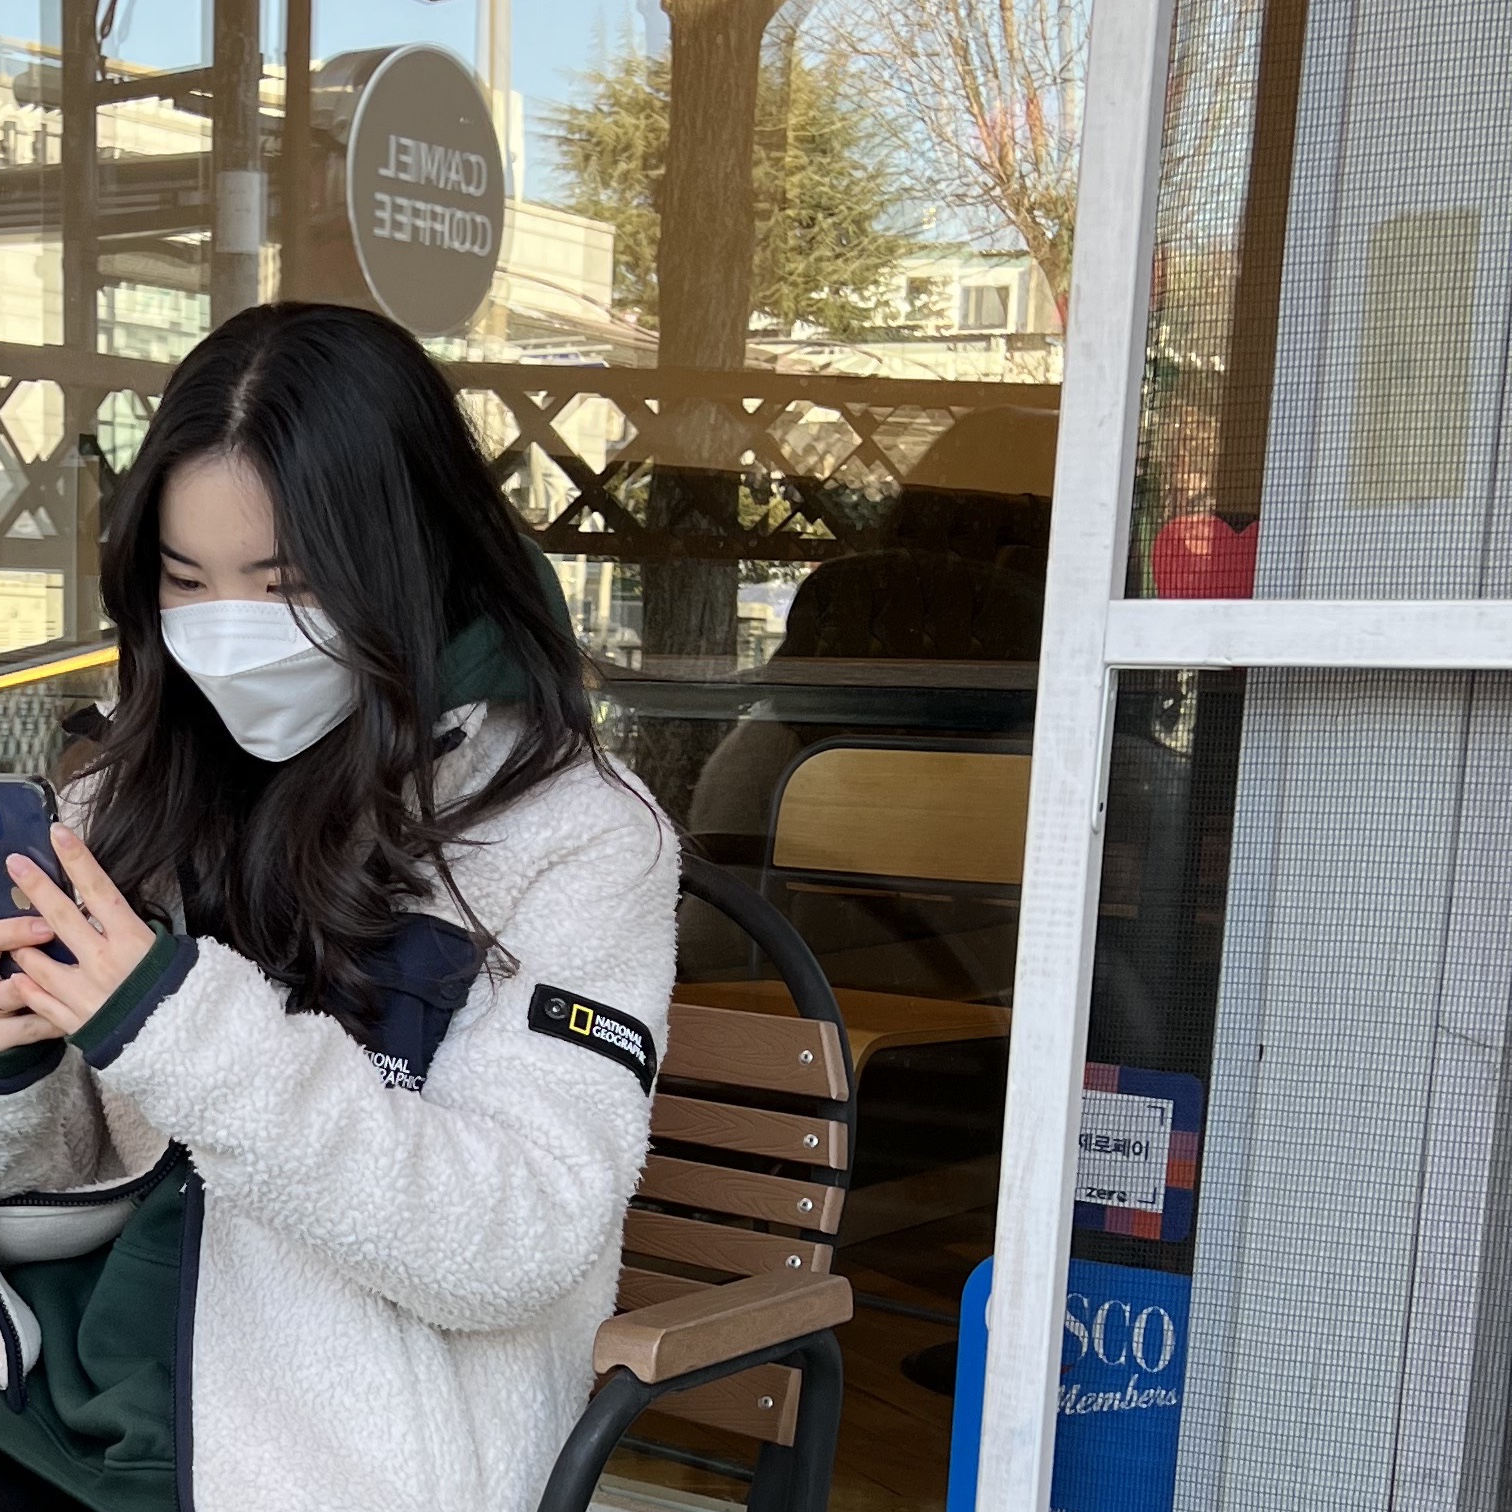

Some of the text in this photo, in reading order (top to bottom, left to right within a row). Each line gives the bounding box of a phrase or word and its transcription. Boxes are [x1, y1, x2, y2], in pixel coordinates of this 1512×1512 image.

[592, 1026, 647, 1066] GEOGRAPHIC
[594, 1014, 643, 1048] NATIONAL
[1086, 1187, 1127, 1203] zero
